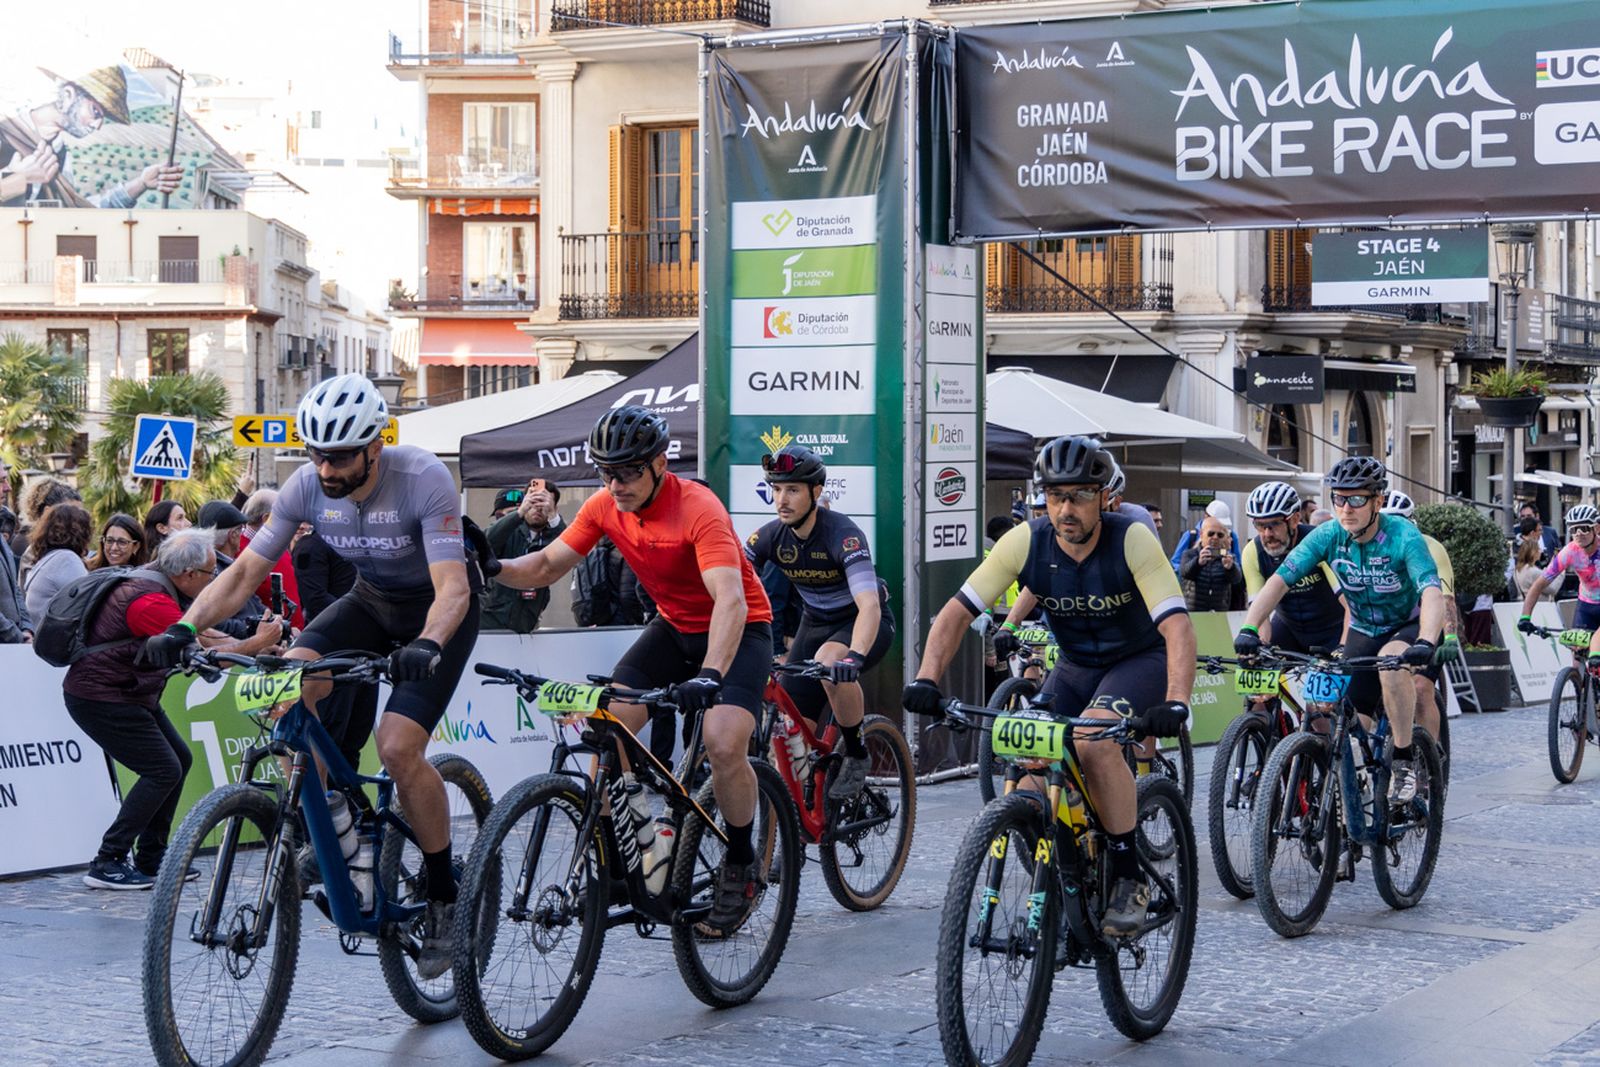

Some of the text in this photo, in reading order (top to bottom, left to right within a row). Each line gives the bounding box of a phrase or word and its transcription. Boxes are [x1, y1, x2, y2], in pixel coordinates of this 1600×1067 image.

[992, 46, 1084, 74] Andalucía
[1550, 53, 1600, 81] UC
[1169, 25, 1515, 122] Andalucía
[742, 97, 871, 138] Andalucía
[1017, 100, 1109, 128] GRANADA
[1036, 127, 1088, 157] JAÉN
[1175, 109, 1533, 182] BIKE RACE BY
[1017, 159, 1109, 188] CÓRDOBA
[796, 215, 850, 228] Diputación
[796, 226, 853, 237] de Granada
[1357, 237, 1441, 255] STAGE 4
[1373, 256, 1425, 276] JAÉN
[1367, 286, 1431, 298] GARMIN
[797, 323, 849, 336] de Córdoba
[798, 312, 849, 325] Diputación
[929, 320, 972, 337] GARMIN
[748, 370, 860, 392] GARMIN
[796, 434, 849, 444] CAJA RURAL
[939, 423, 964, 443] Jaén
[1561, 631, 1589, 644] 421-2
[1238, 670, 1276, 689] 409-2
[543, 682, 597, 704] 406-1
[432, 700, 497, 744] alucía
[997, 720, 1056, 753] 409-1
[0, 739, 82, 769] MIENTO
